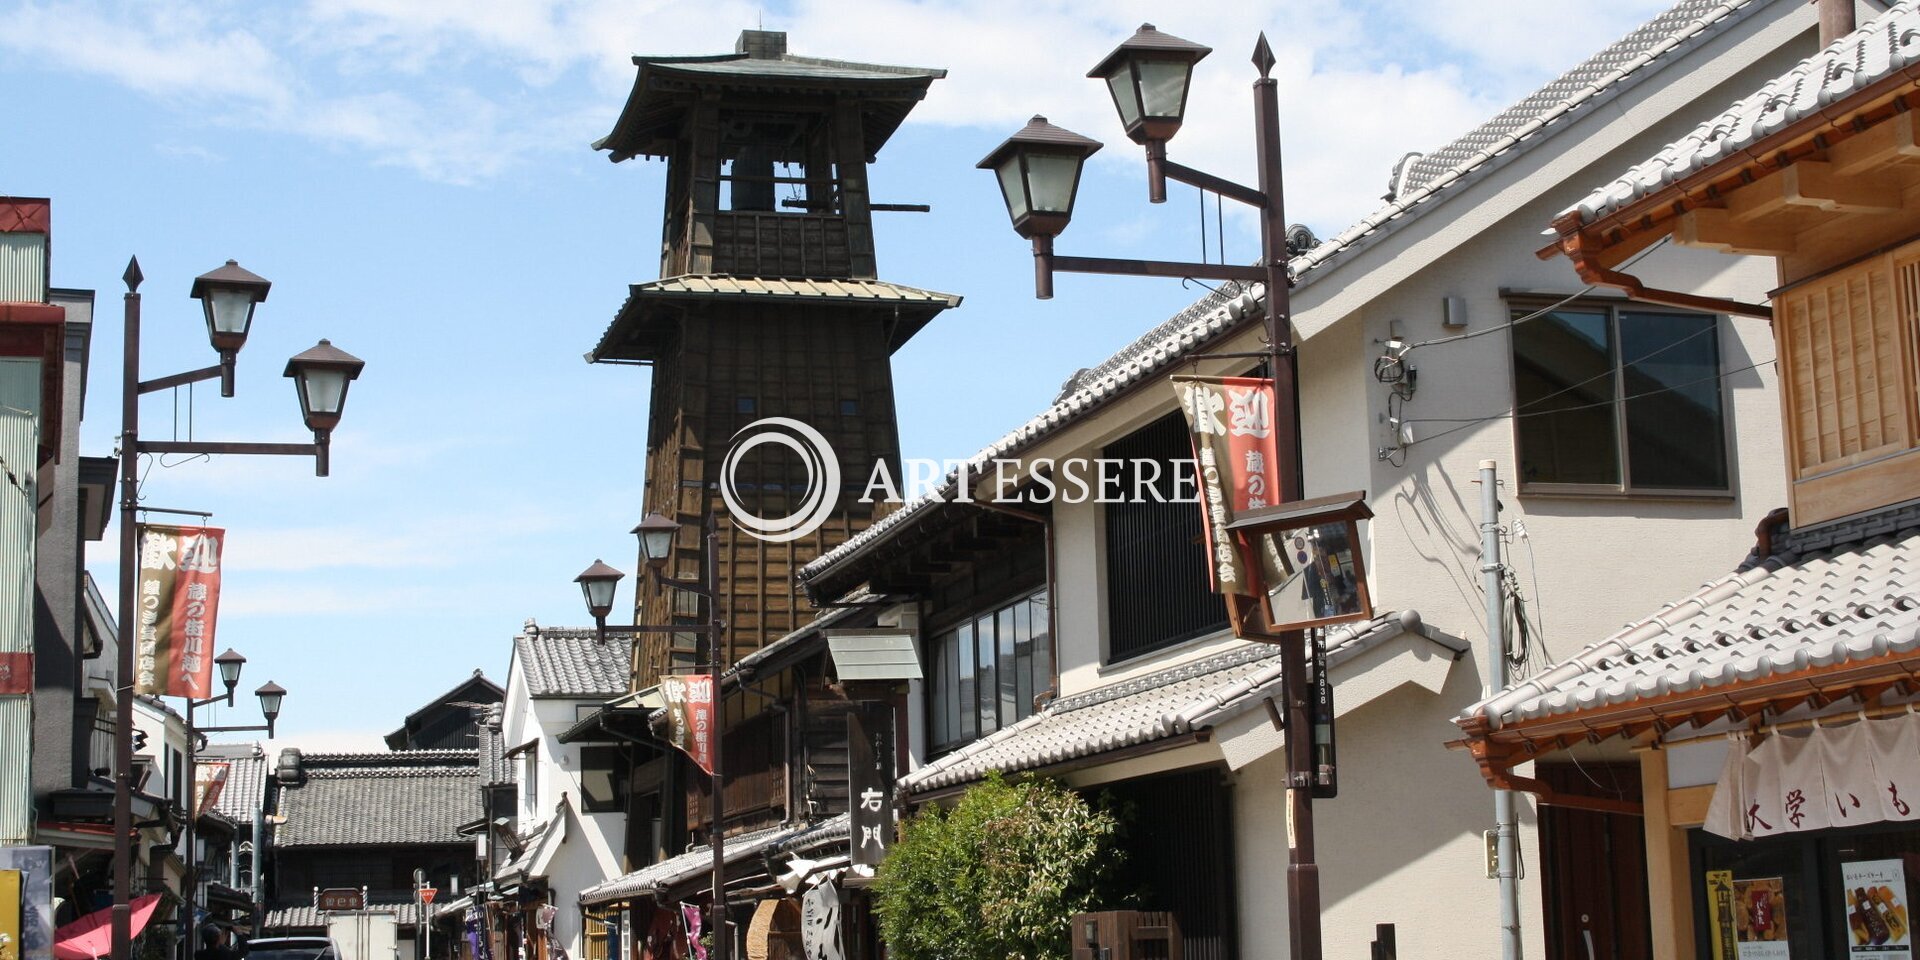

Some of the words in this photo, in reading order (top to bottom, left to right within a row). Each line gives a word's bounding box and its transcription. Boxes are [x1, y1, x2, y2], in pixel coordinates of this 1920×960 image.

[1184, 385, 1270, 438] 歓迎
[141, 533, 218, 573] 歓迎
[181, 582, 207, 690] 蔵の街川越へ
[860, 787, 884, 849] 右門
[1747, 780, 1911, 830] 大学いも
